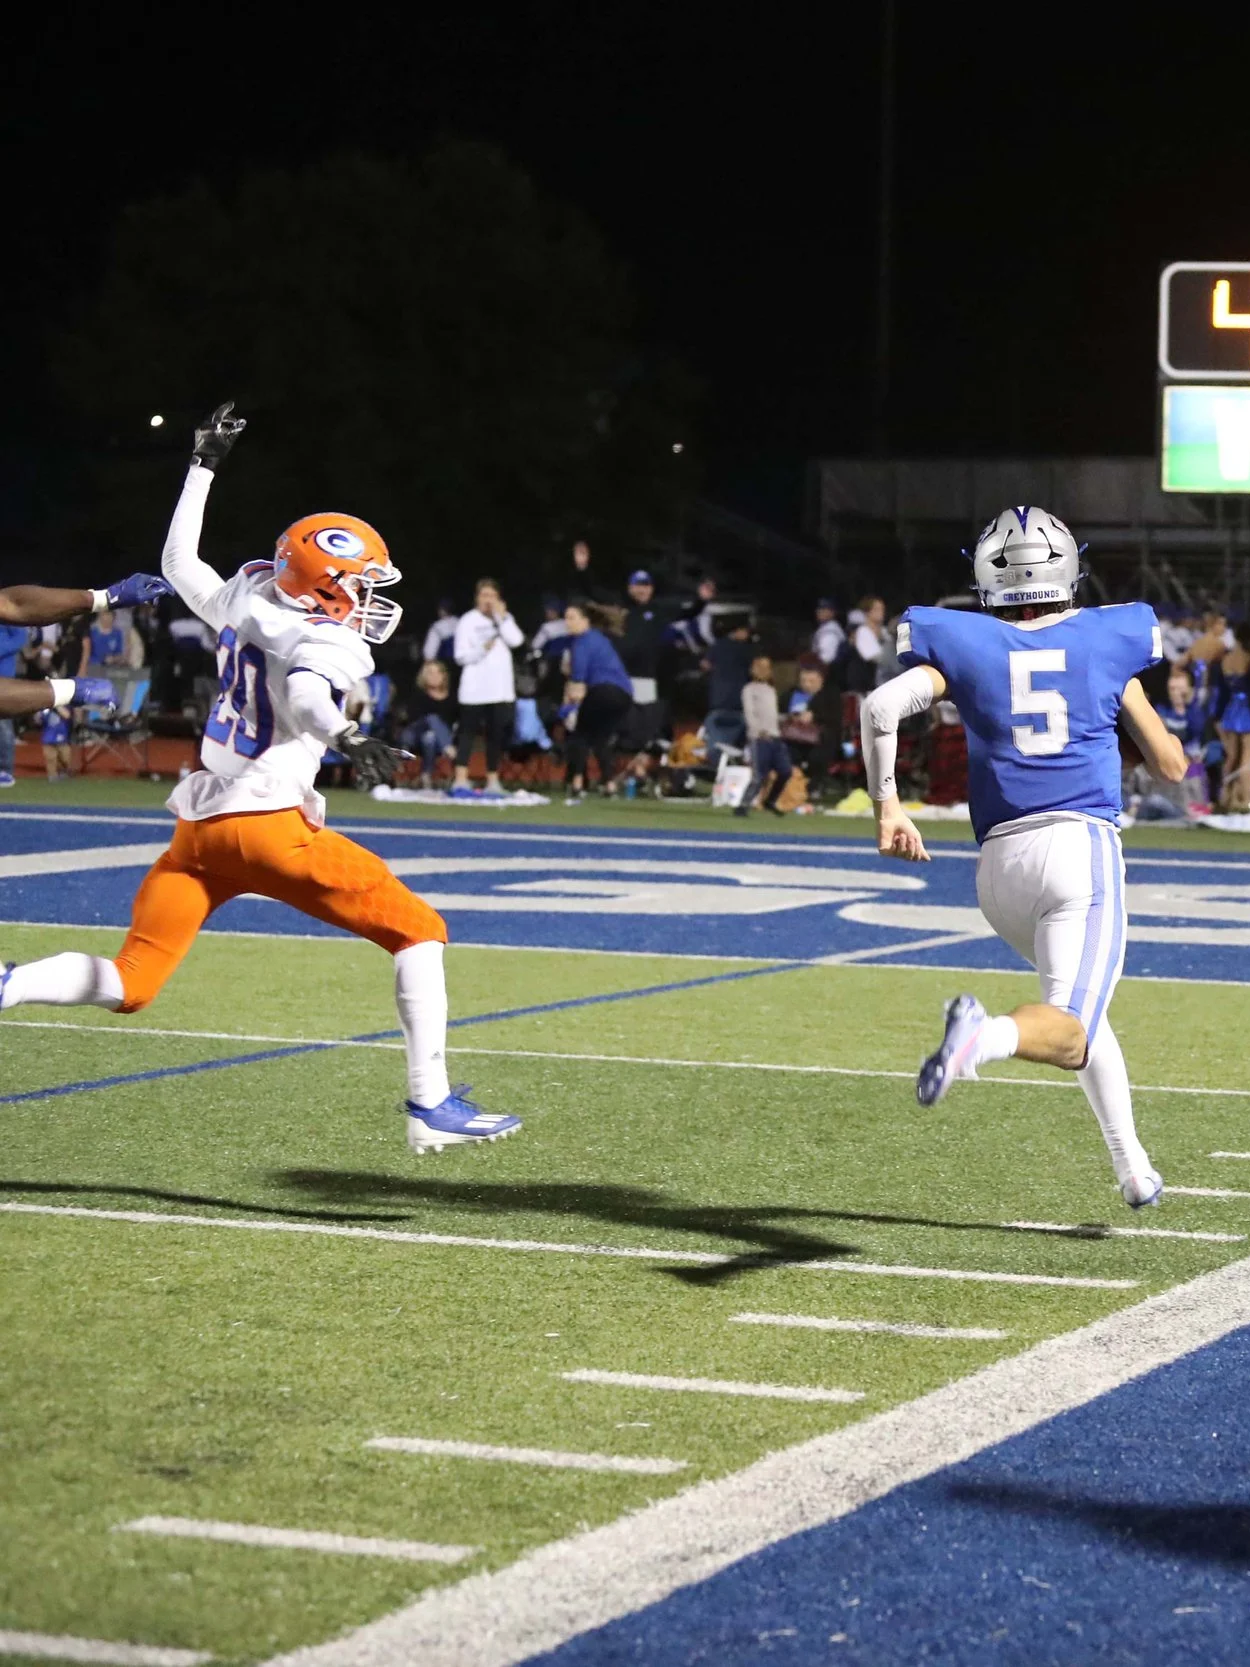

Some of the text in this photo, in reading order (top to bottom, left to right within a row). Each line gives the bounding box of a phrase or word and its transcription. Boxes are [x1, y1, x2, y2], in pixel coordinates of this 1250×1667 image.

[1002, 589, 1060, 602] GREYHOUNDS
[203, 624, 275, 760] 20
[1008, 649, 1070, 756] 5
